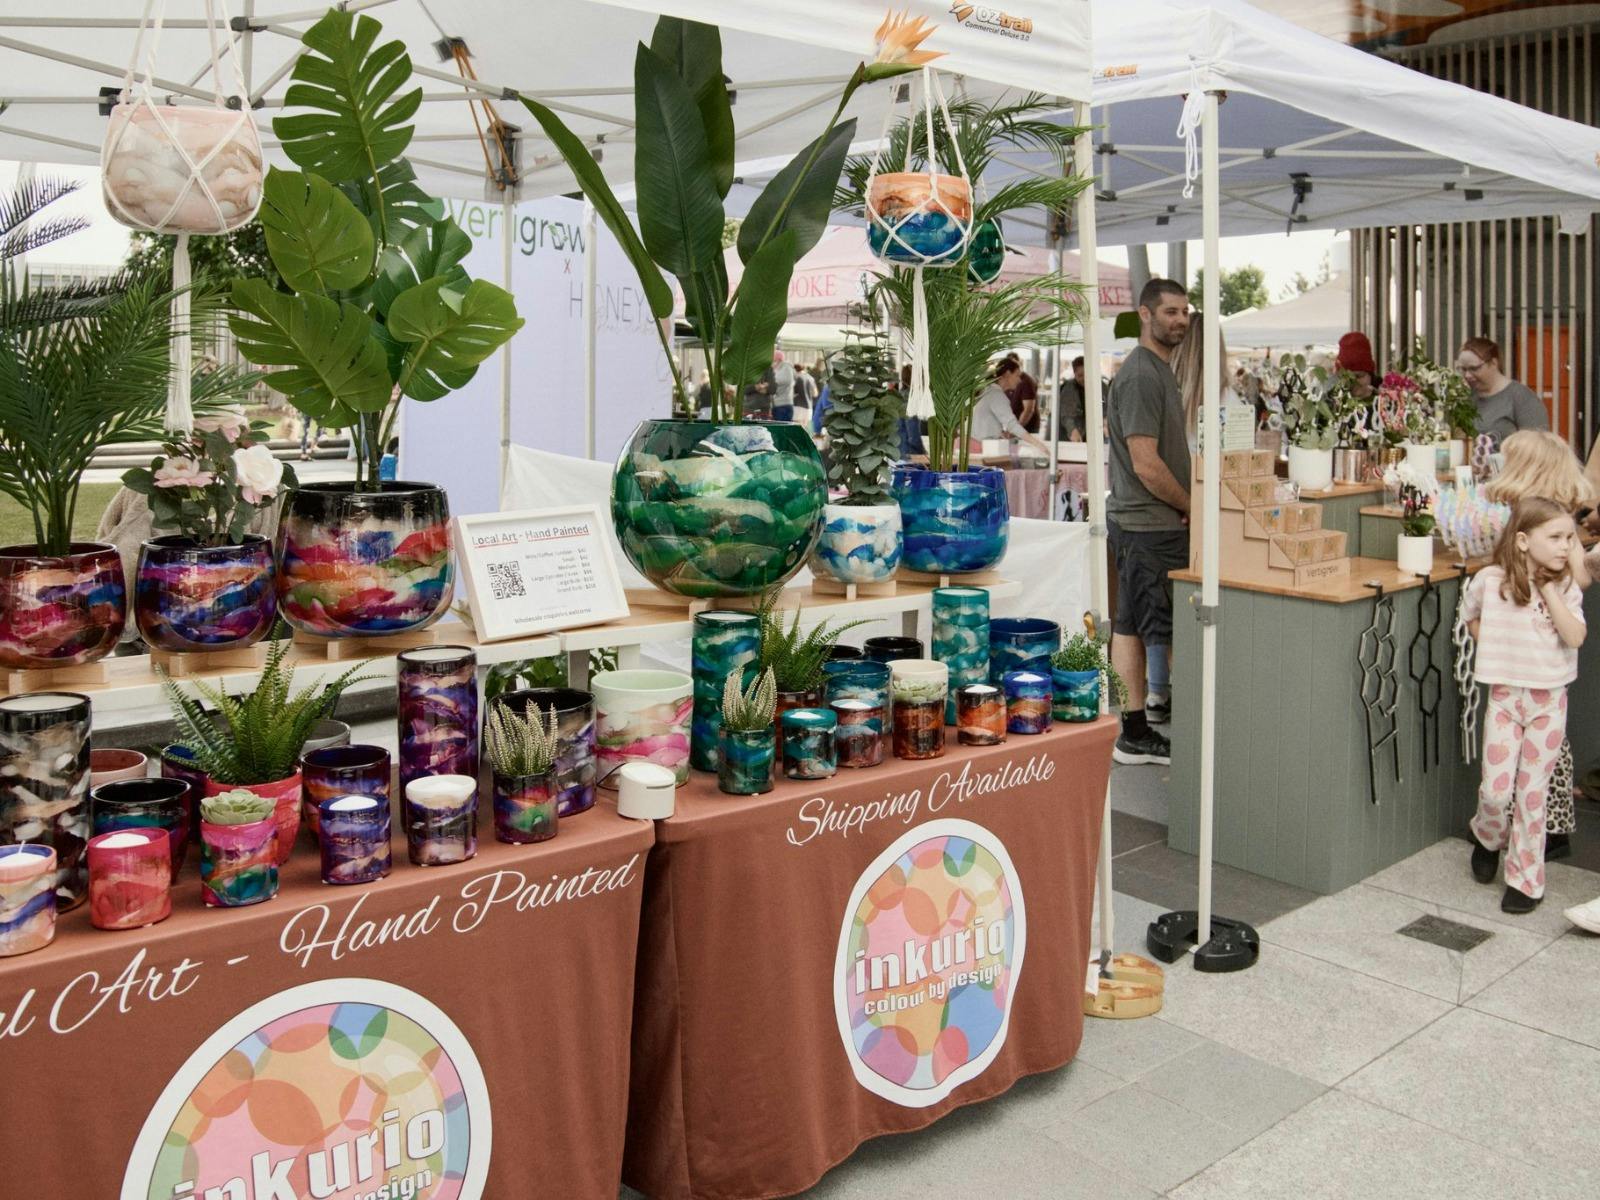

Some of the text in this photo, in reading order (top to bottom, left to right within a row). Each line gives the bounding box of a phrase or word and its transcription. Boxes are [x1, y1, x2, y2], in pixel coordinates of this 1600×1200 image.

[964, 20, 1000, 33] Commercial
[1000, 29, 1019, 40] Deluxe
[471, 533, 499, 546] Local
[501, 532, 518, 543] Art
[525, 528, 550, 540] Hand
[552, 523, 590, 537] Painted
[786, 753, 1056, 847] Shipping Available
[49, 947, 203, 1034] Art
[279, 892, 441, 969] Hand
[452, 853, 640, 934] Painted
[855, 917, 1006, 996] inkurio
[864, 963, 1002, 1016] colour by design
